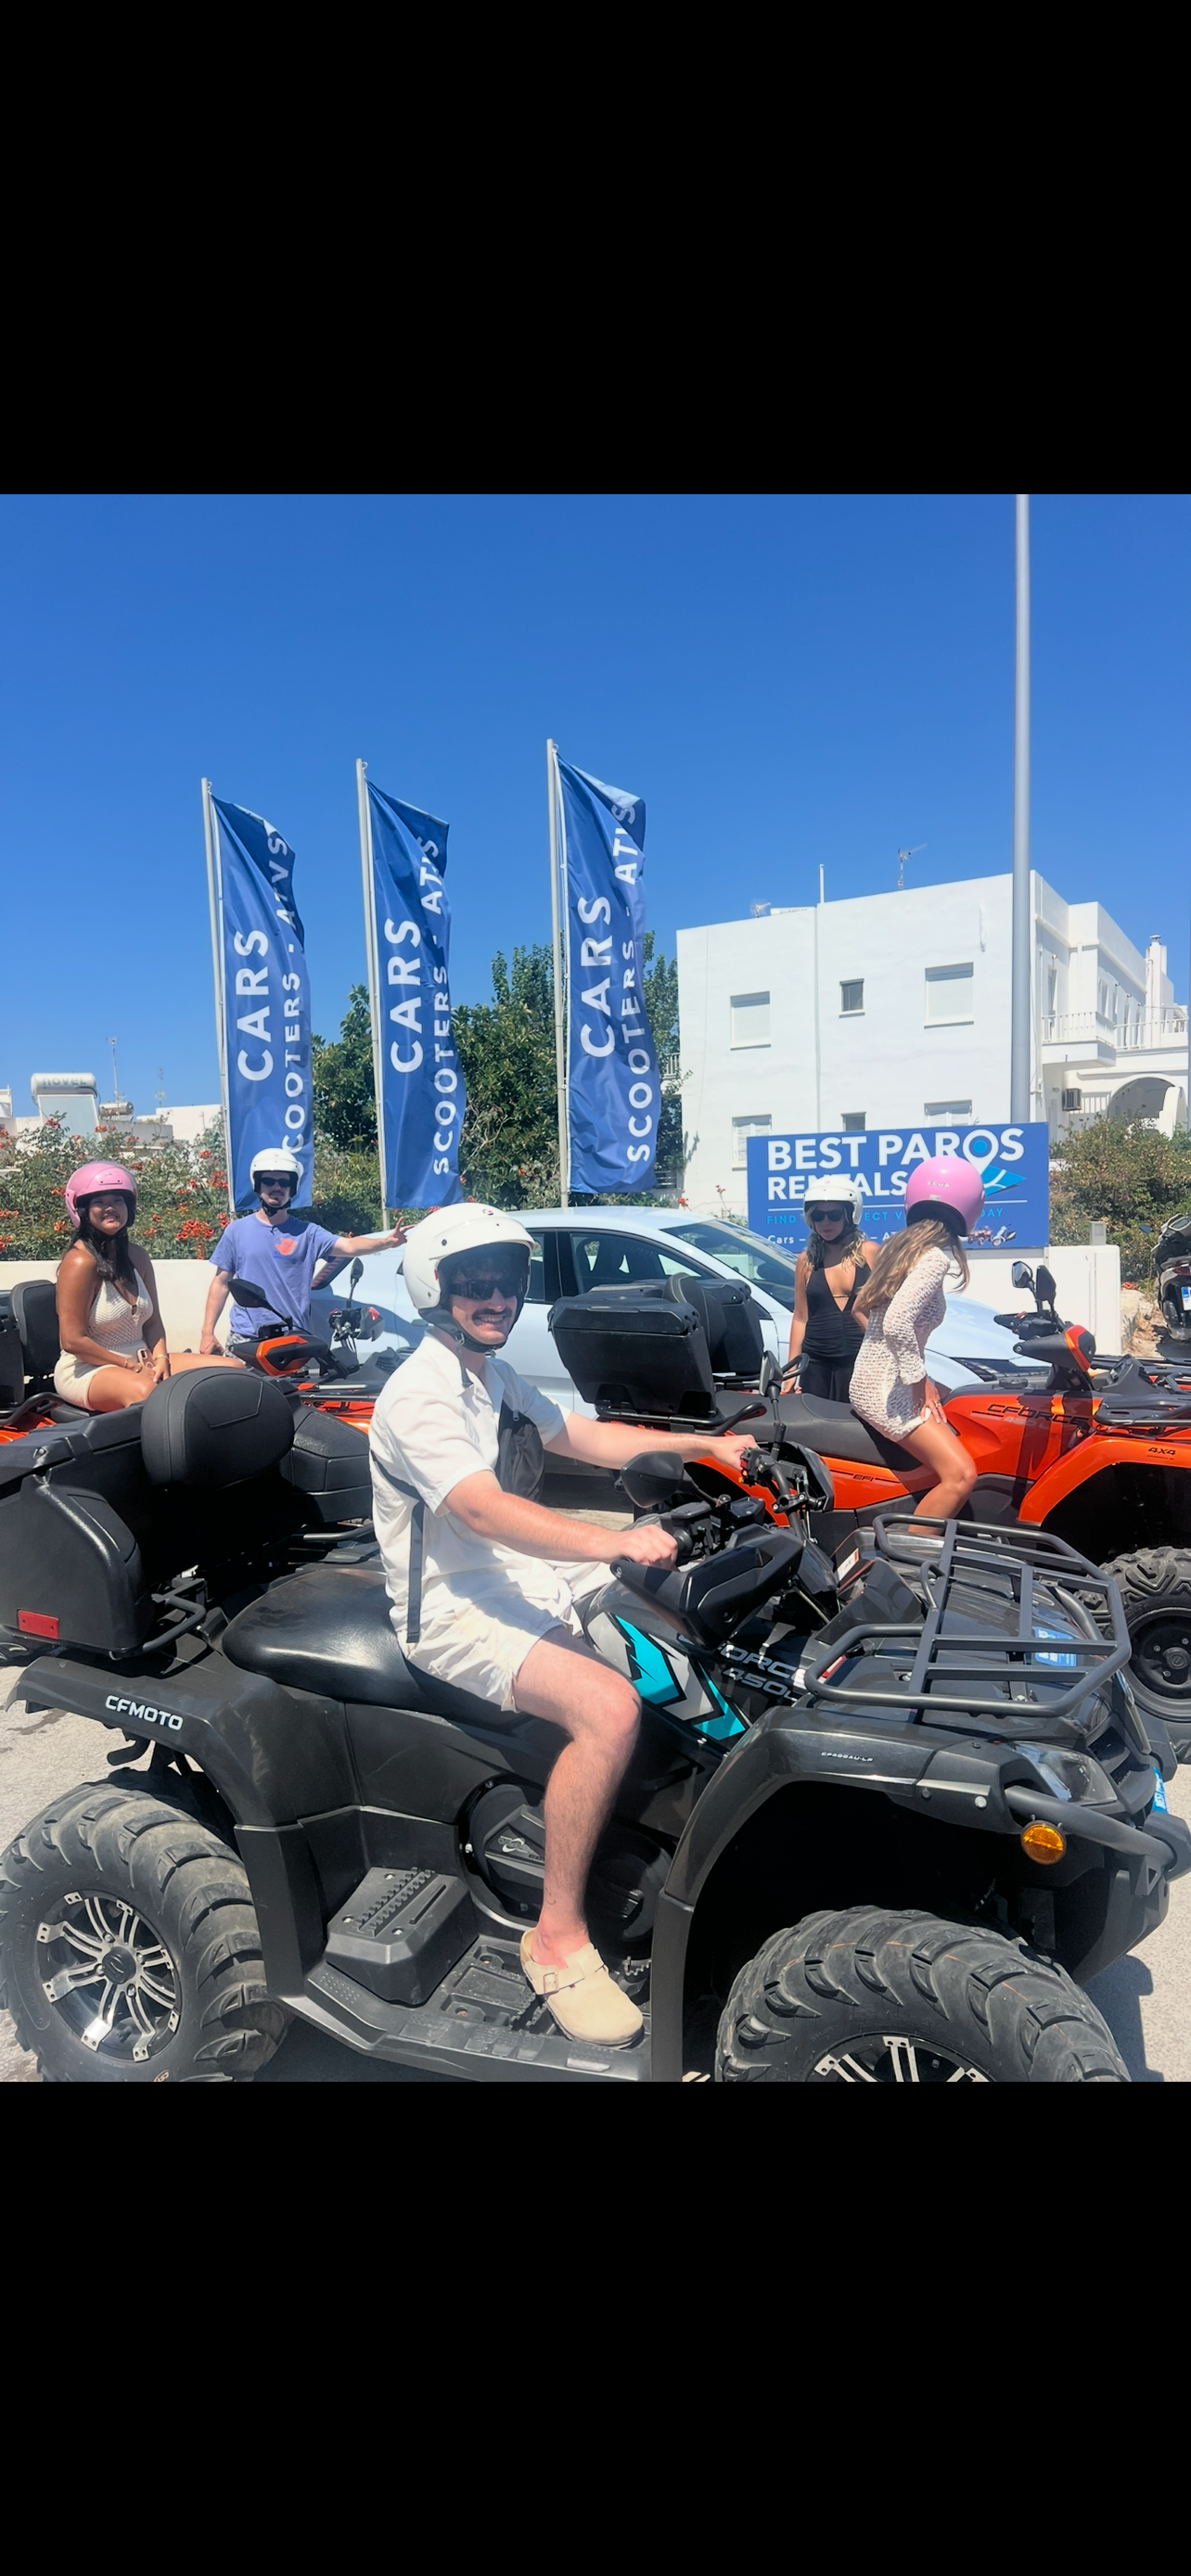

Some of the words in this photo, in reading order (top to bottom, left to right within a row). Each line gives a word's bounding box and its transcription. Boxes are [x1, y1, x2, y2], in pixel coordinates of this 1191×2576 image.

[233, 930, 275, 1082] CARS
[384, 918, 424, 1074] CARS
[577, 897, 616, 1058] CARS
[280, 972, 306, 1180] COOTERS
[433, 965, 458, 1176] SCOOTERS
[622, 939, 653, 1163] SCOOTERS
[767, 1136, 867, 1171] BEST
[878, 1128, 1025, 1167] PAROS
[766, 1215, 797, 1225] FIND
[980, 1207, 1004, 1218] DAY
[767, 1234, 795, 1244] Cars
[987, 1403, 1091, 1425] CFORCE
[852, 1473, 874, 1483] EFI
[105, 1694, 184, 1731] CFMOTO
